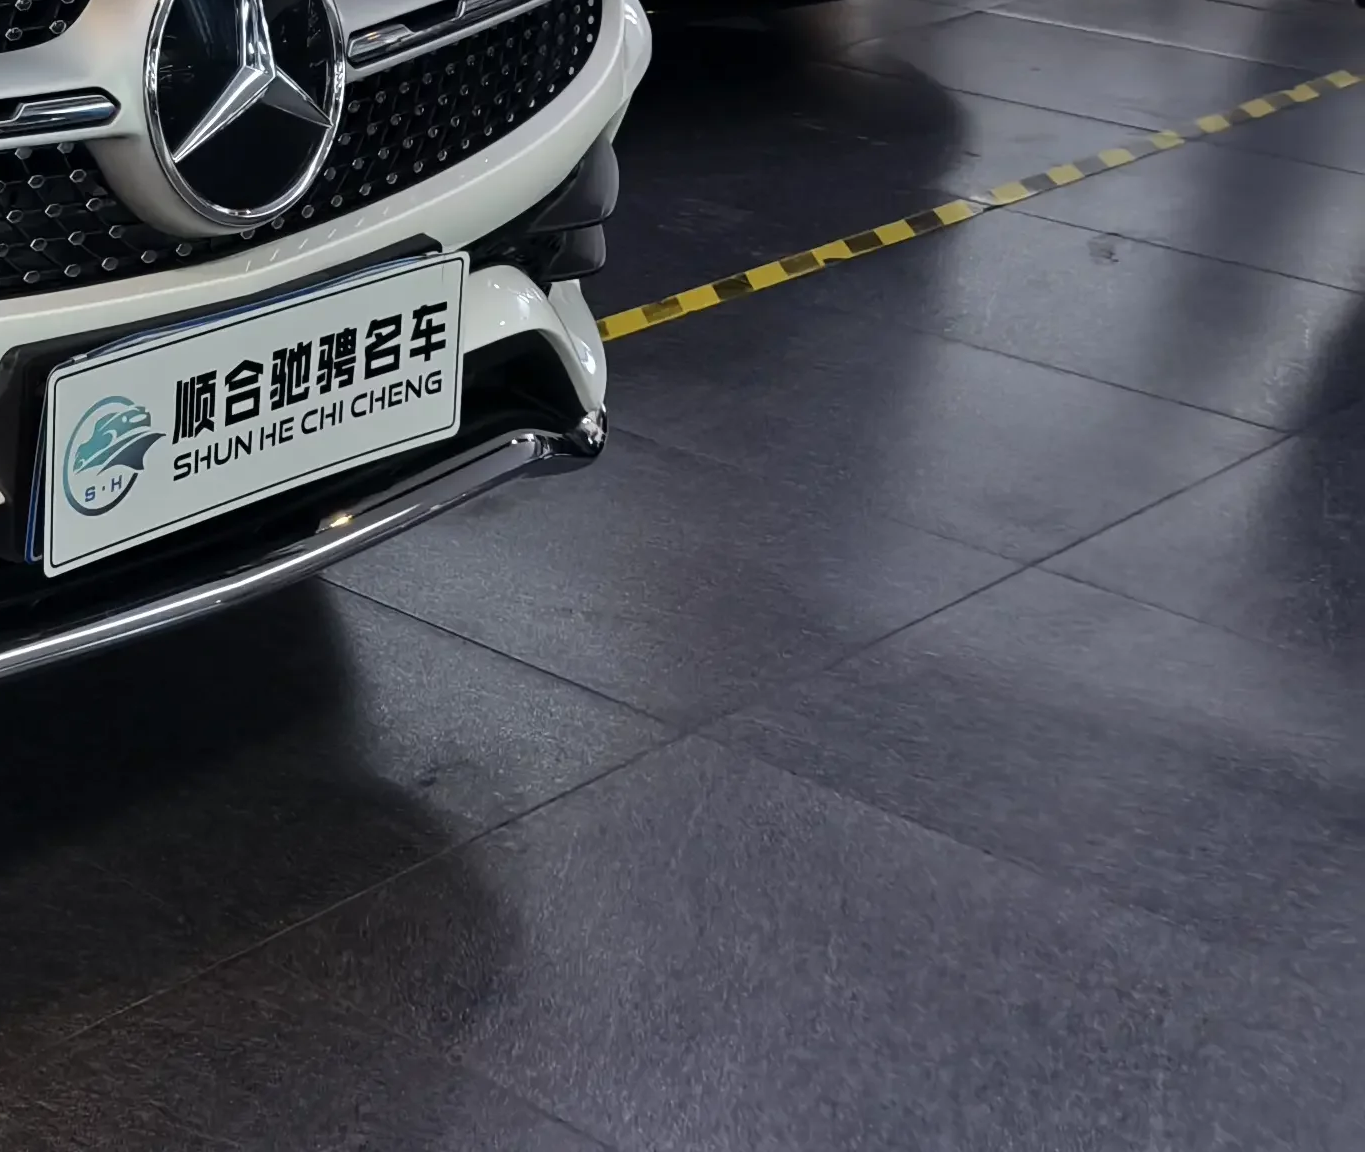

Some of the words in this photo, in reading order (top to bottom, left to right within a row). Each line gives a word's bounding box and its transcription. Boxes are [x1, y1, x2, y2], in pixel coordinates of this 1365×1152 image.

[172, 301, 448, 445] 顺合驰骋名车
[173, 431, 252, 482] SHUN
[259, 416, 295, 451] HE
[301, 400, 344, 435] CHI
[350, 370, 443, 418] CHENG
